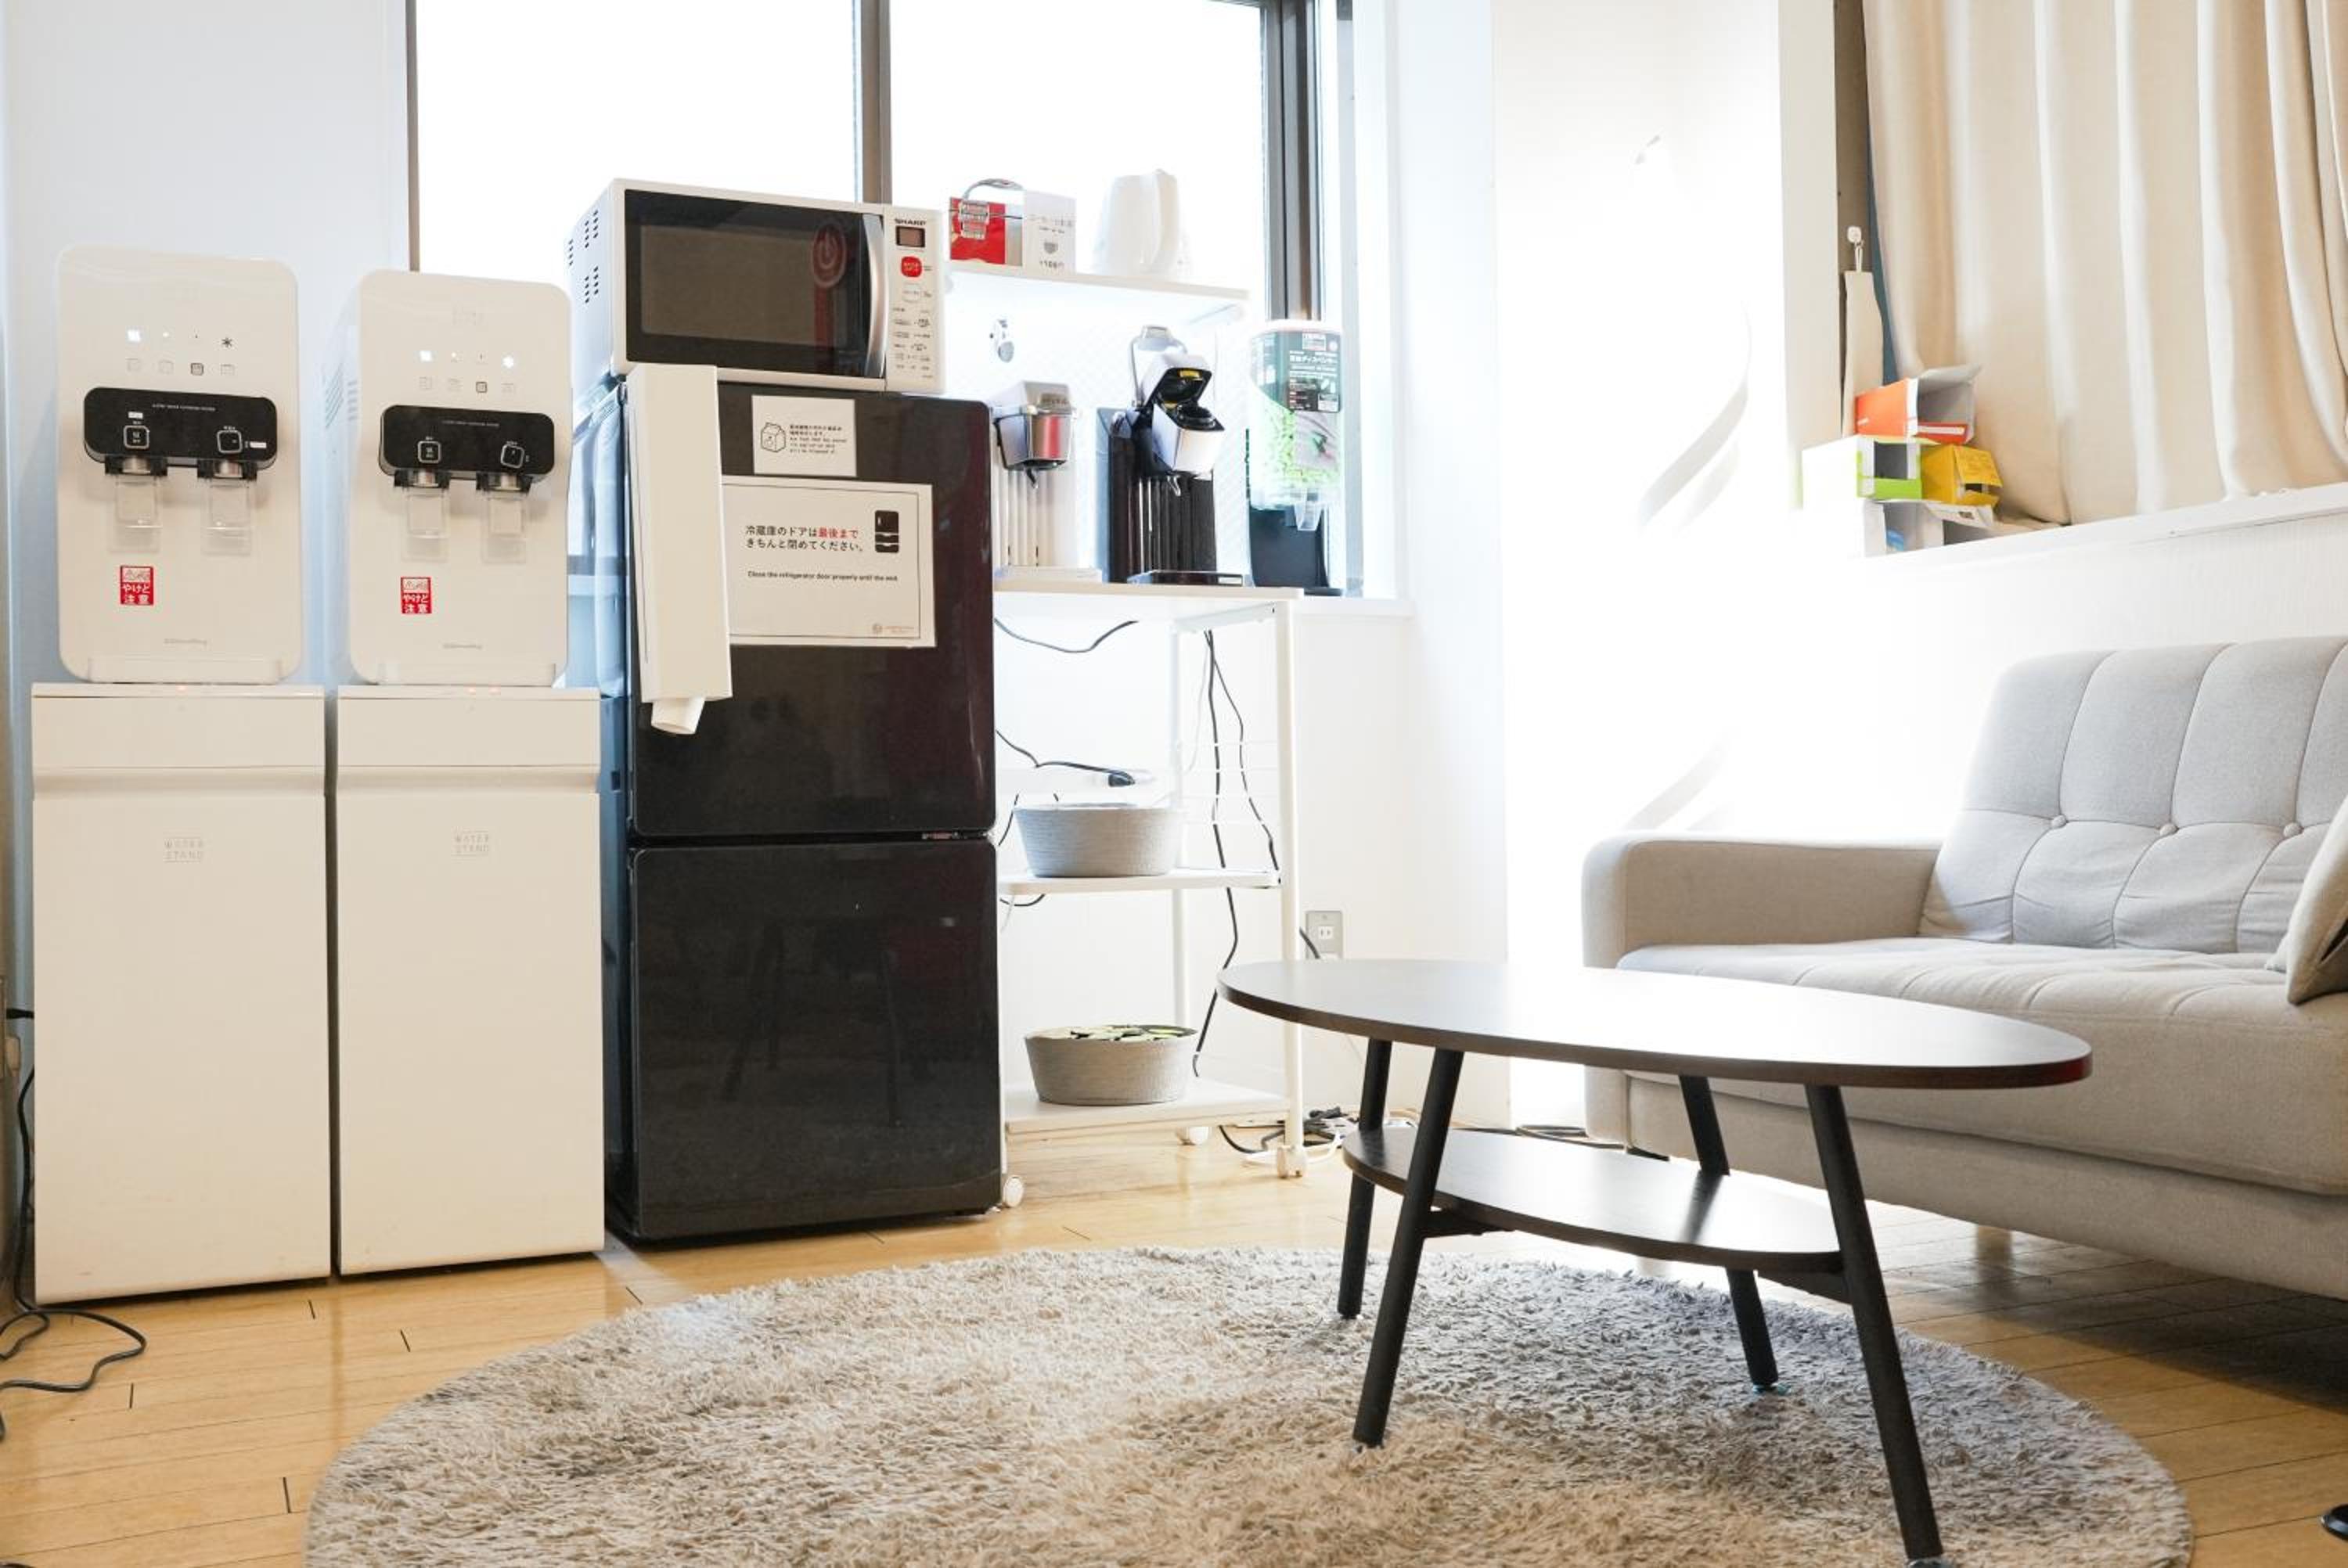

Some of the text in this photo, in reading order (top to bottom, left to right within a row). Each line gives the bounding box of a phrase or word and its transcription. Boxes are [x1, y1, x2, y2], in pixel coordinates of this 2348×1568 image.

[746, 525, 859, 539] 冷蔵庫のドアは最後まで
[746, 538, 863, 552] きちんと閉めてください。
[779, 572, 815, 581] refrigerator
[123, 584, 151, 594] やけど
[124, 594, 149, 604] 注意
[402, 594, 429, 603] やけど
[404, 603, 428, 613] 注意
